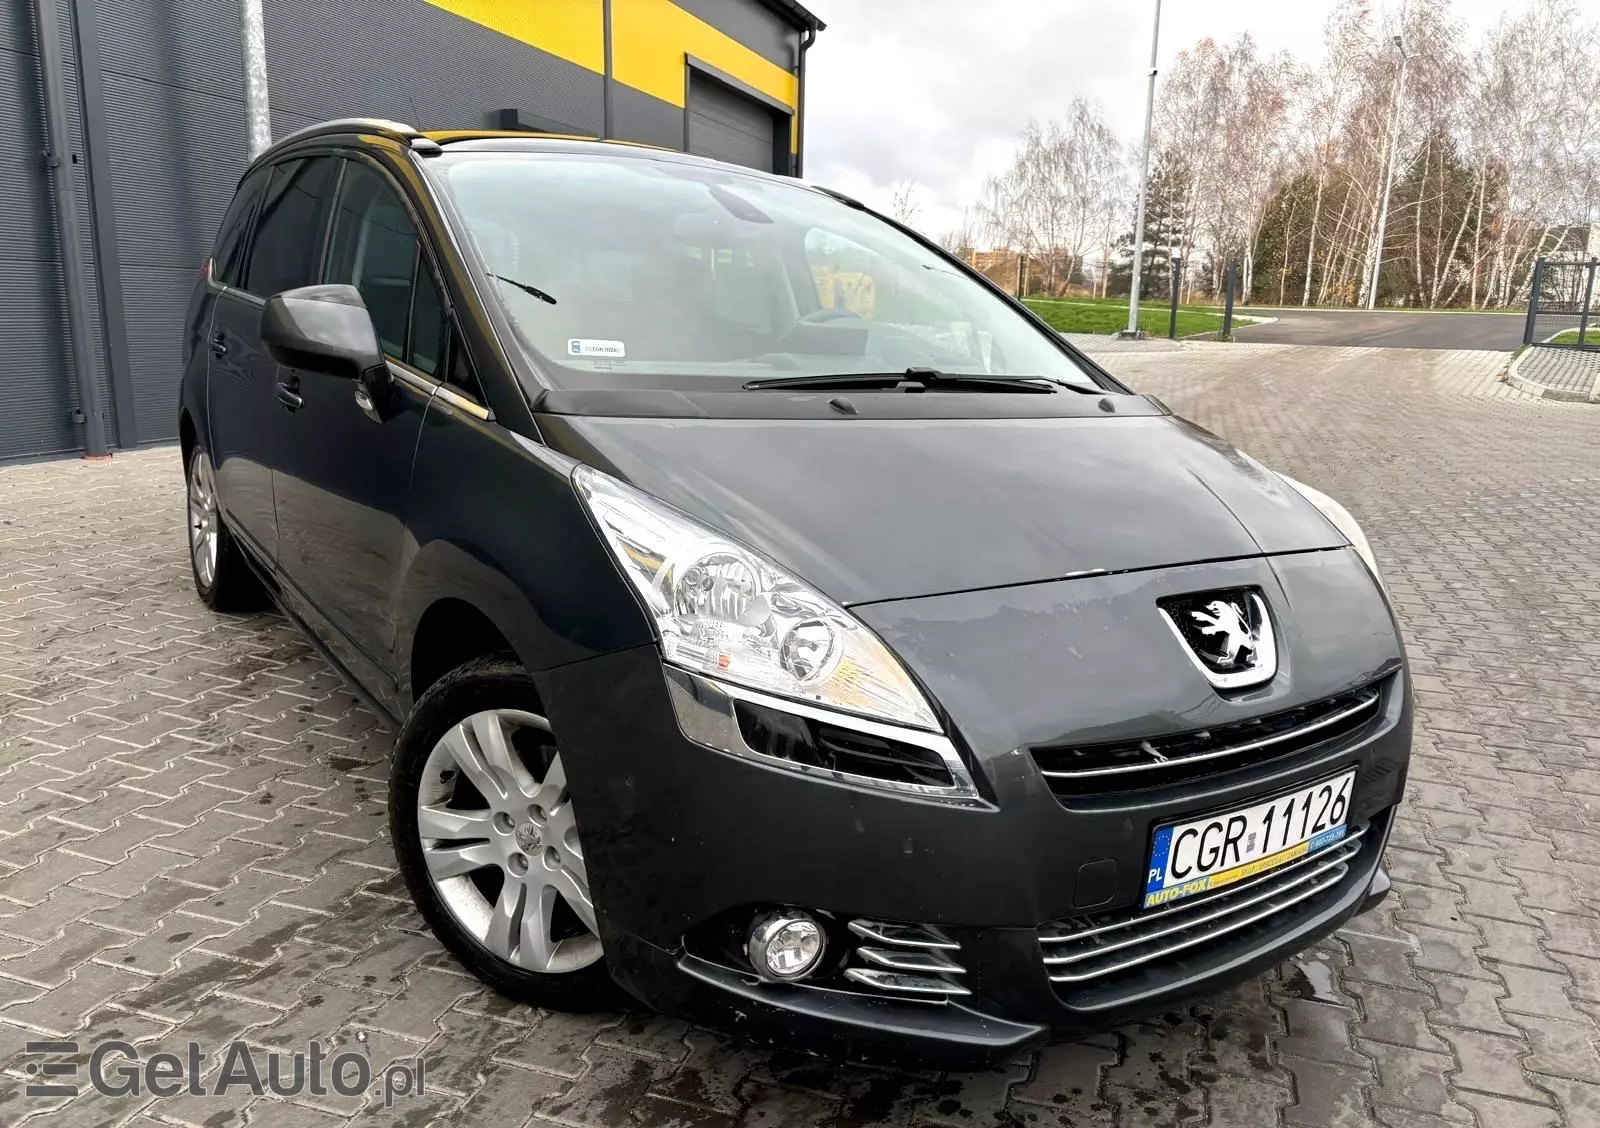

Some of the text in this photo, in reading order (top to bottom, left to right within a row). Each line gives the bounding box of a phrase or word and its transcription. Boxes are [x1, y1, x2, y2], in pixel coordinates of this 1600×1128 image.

[1171, 777, 1351, 879] CGR 11126
[1148, 868, 1162, 884] PL
[1146, 878, 1210, 906] AUTO-FOX
